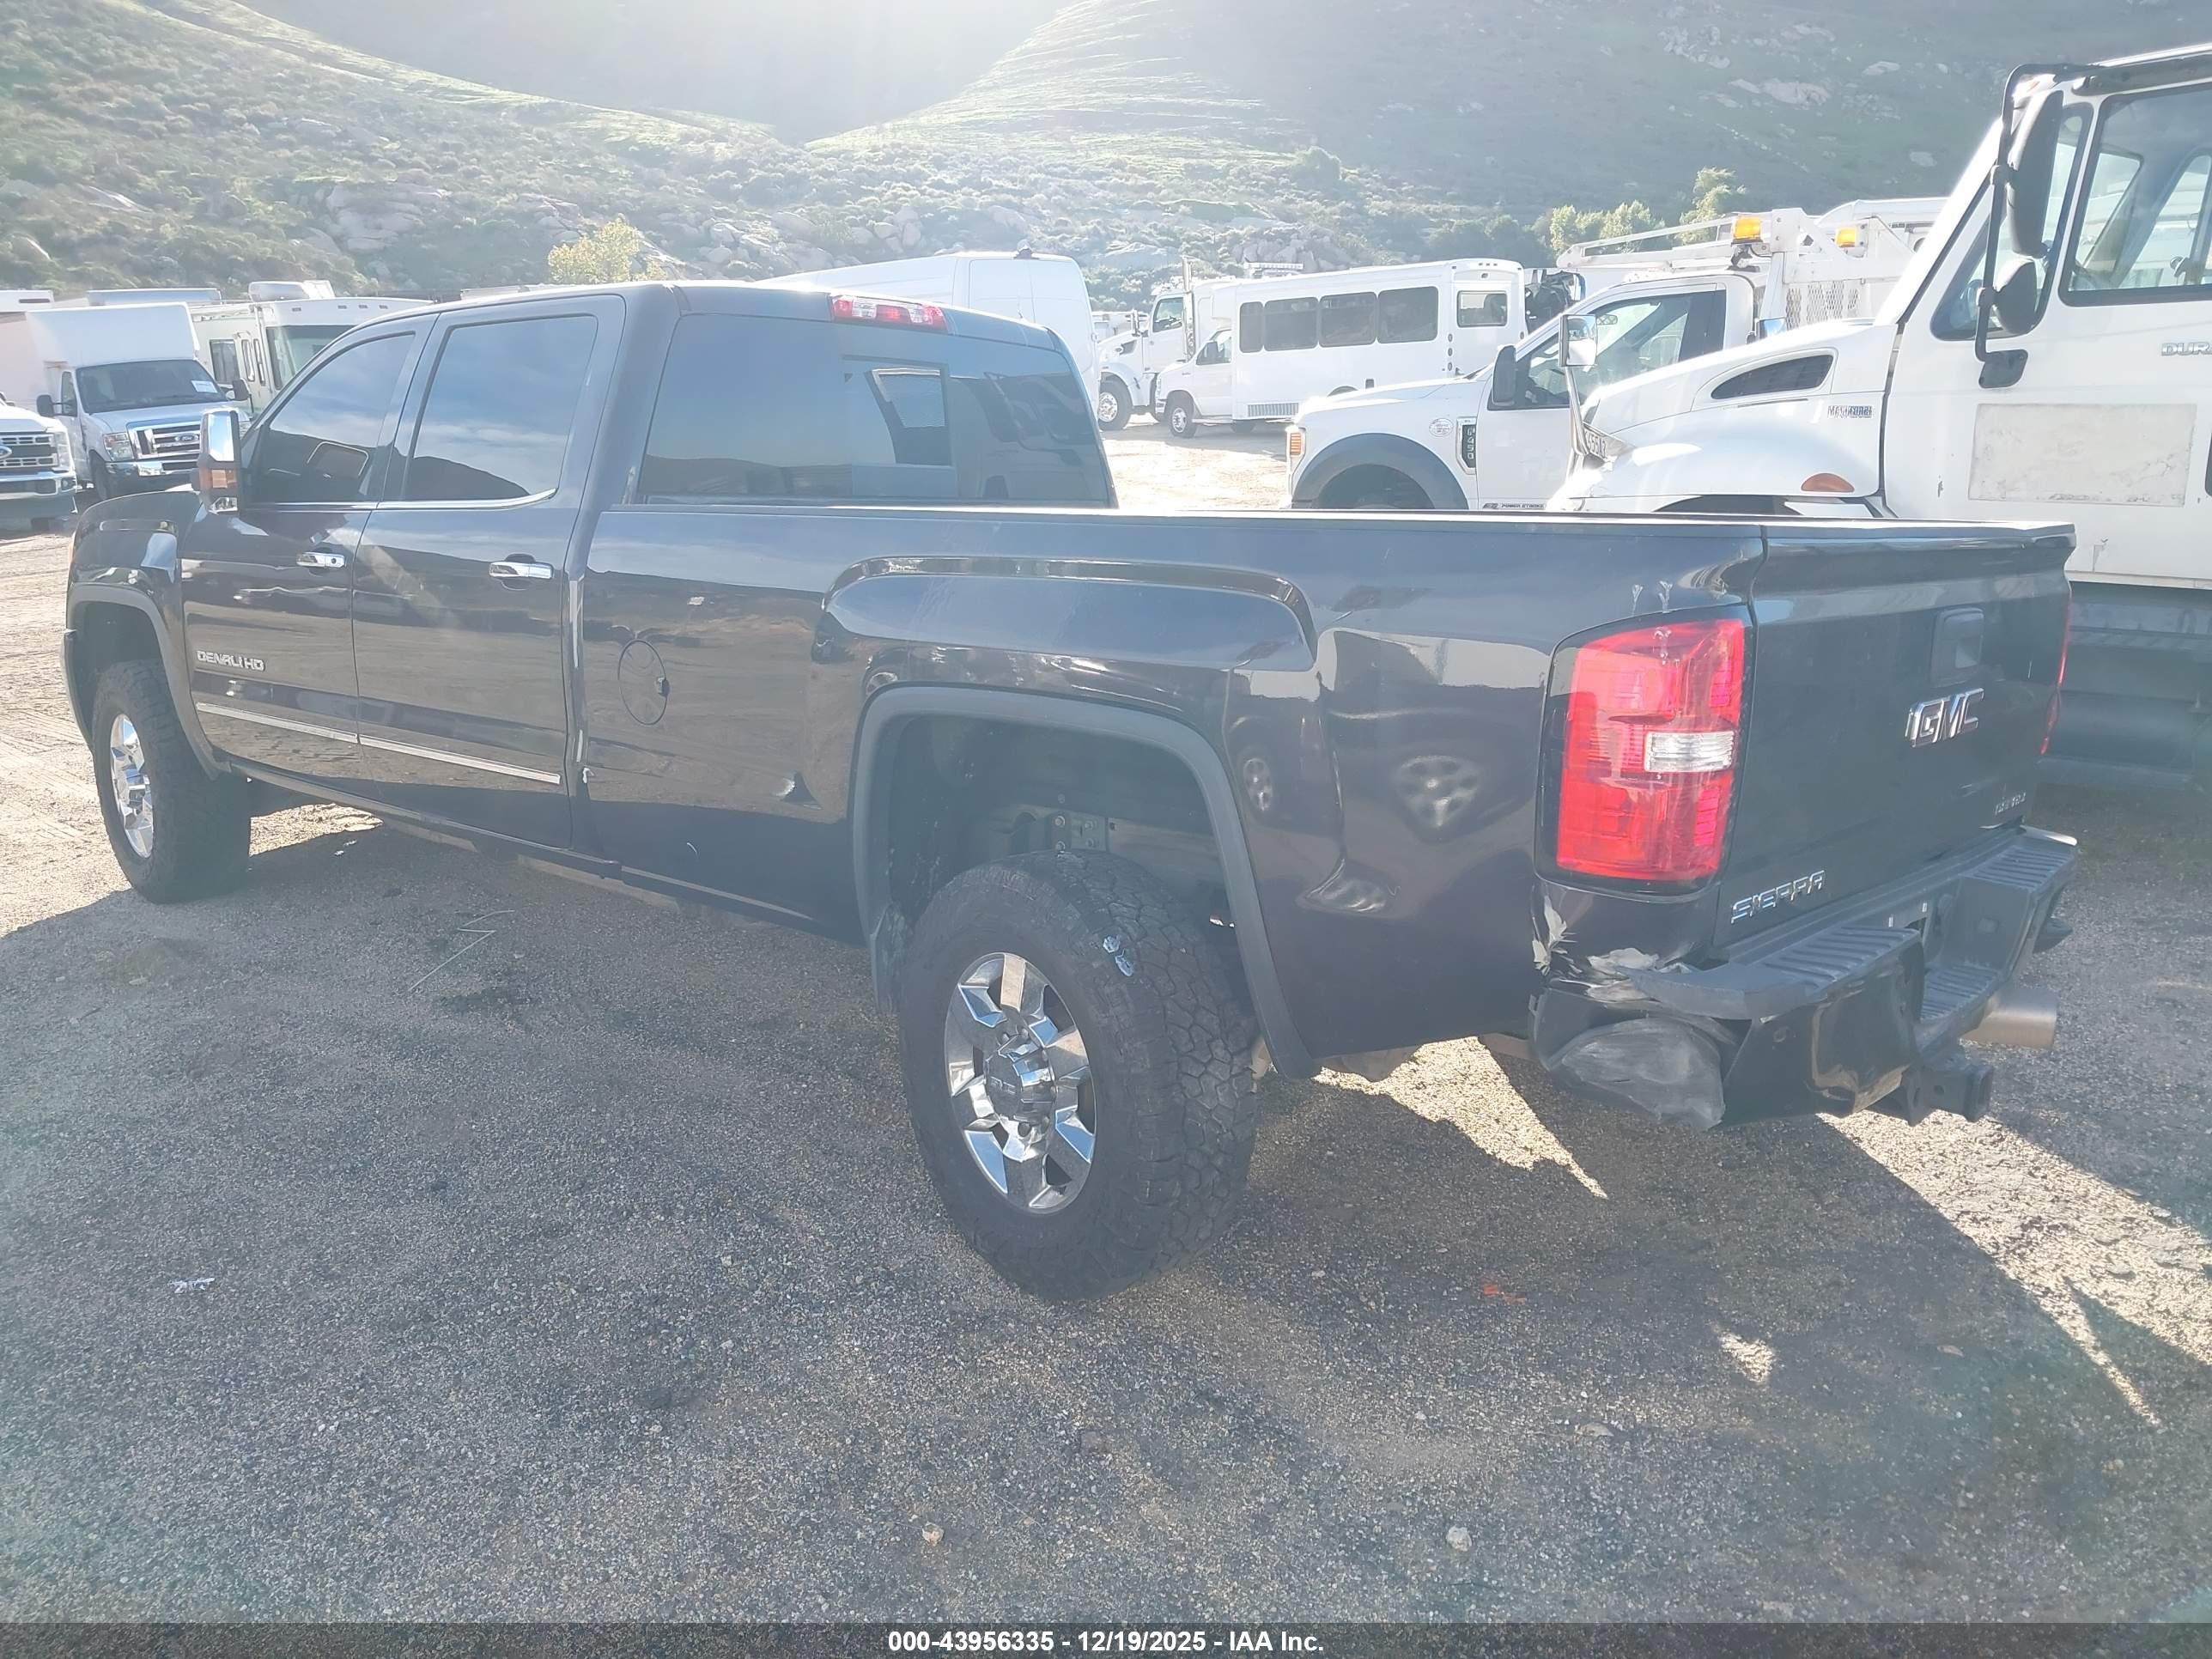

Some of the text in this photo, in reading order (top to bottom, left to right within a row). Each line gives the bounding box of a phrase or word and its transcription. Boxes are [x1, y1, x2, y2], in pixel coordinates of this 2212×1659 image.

[197, 651, 265, 671] DENALI HD
[1905, 688, 1984, 748] GMC
[1731, 870, 1825, 924] SIERRA
